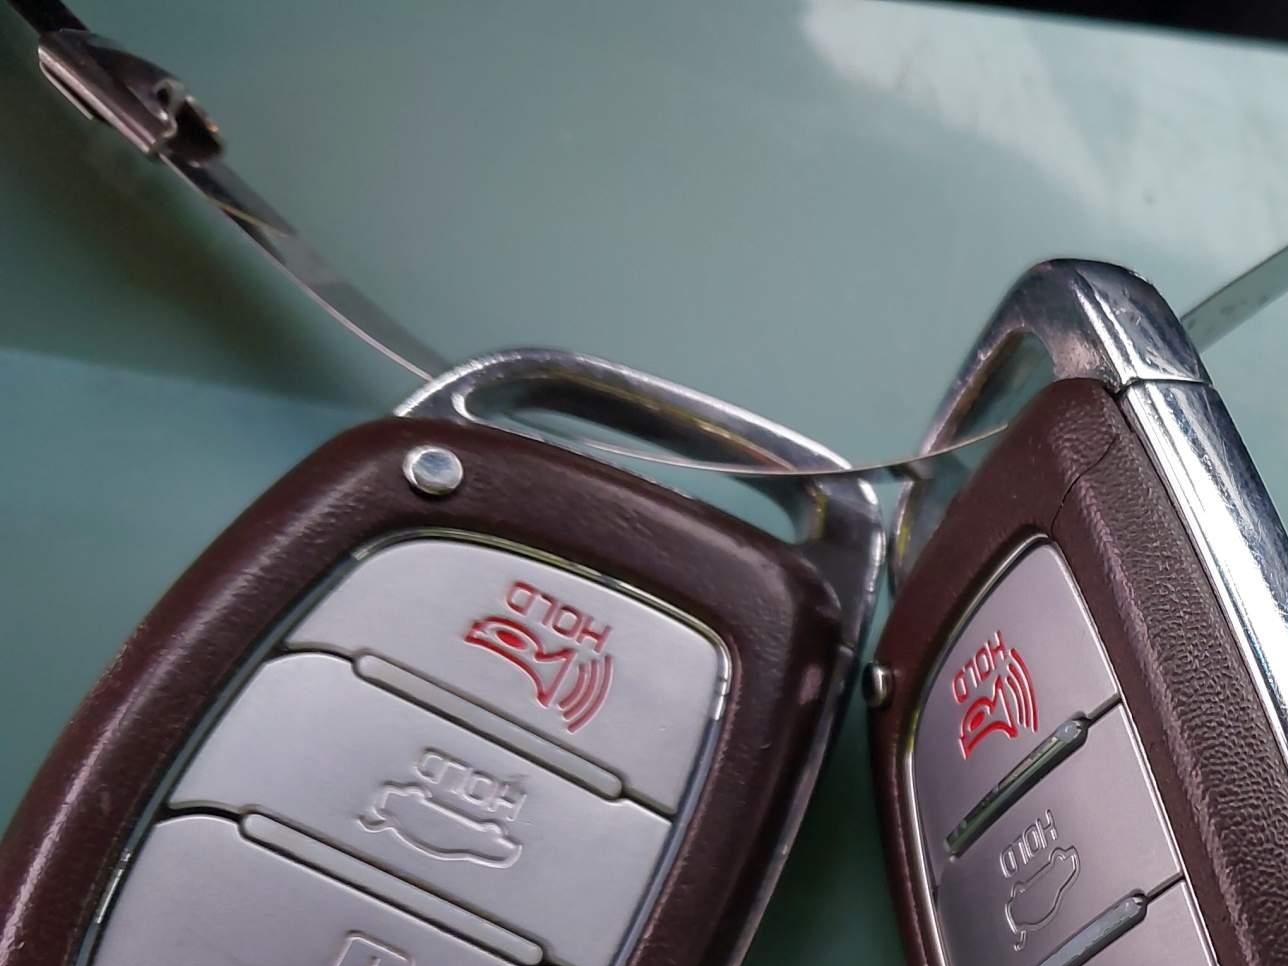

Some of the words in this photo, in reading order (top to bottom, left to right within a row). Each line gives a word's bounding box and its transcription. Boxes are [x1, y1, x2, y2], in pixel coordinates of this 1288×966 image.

[506, 581, 612, 654] HOLD
[952, 630, 1007, 704] HOLD
[413, 747, 527, 822] HOLD
[999, 809, 1058, 878] HOLD
